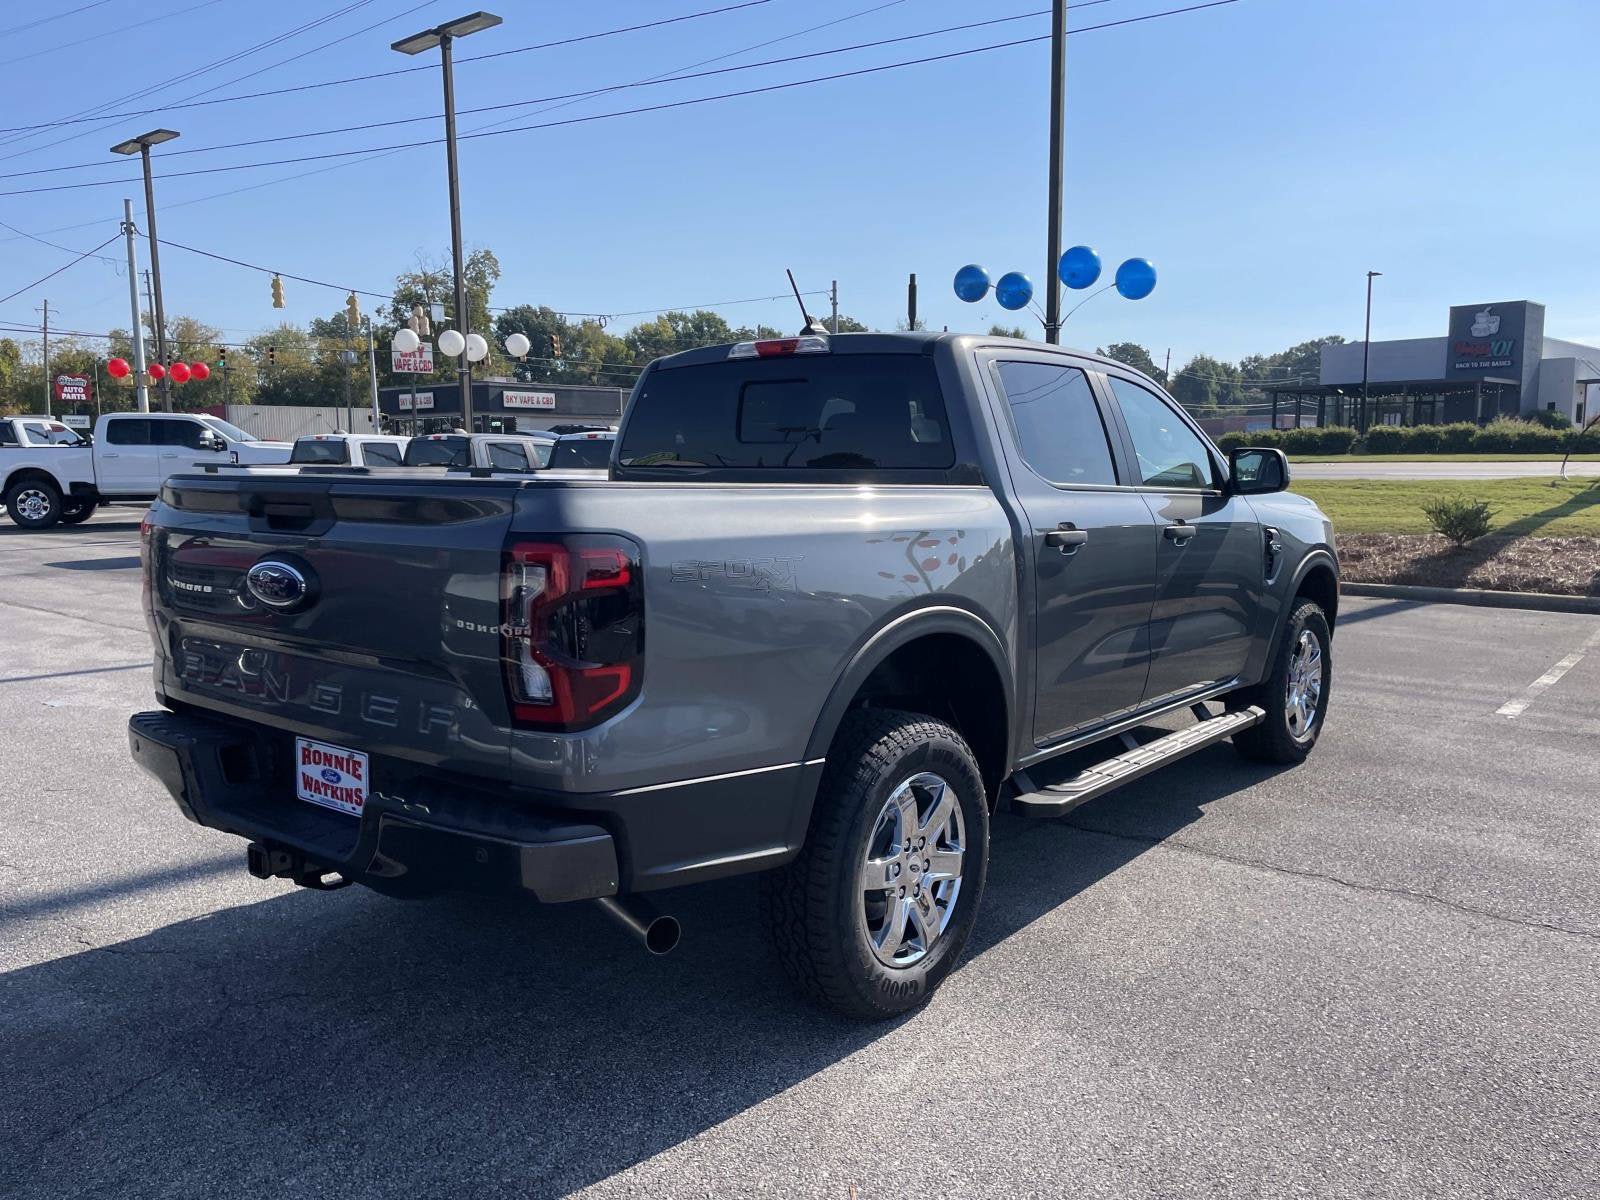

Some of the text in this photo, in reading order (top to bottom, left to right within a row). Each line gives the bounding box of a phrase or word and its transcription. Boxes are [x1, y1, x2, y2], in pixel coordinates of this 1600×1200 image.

[394, 358, 433, 372] VAPE & CBD
[505, 394, 518, 404] SKY
[519, 395, 535, 405] VAPE
[542, 396, 554, 405] CBD
[670, 553, 807, 583] SPORT
[181, 650, 462, 739] RANGER
[301, 746, 363, 782] RONNIE
[301, 772, 364, 807] WATKINS
